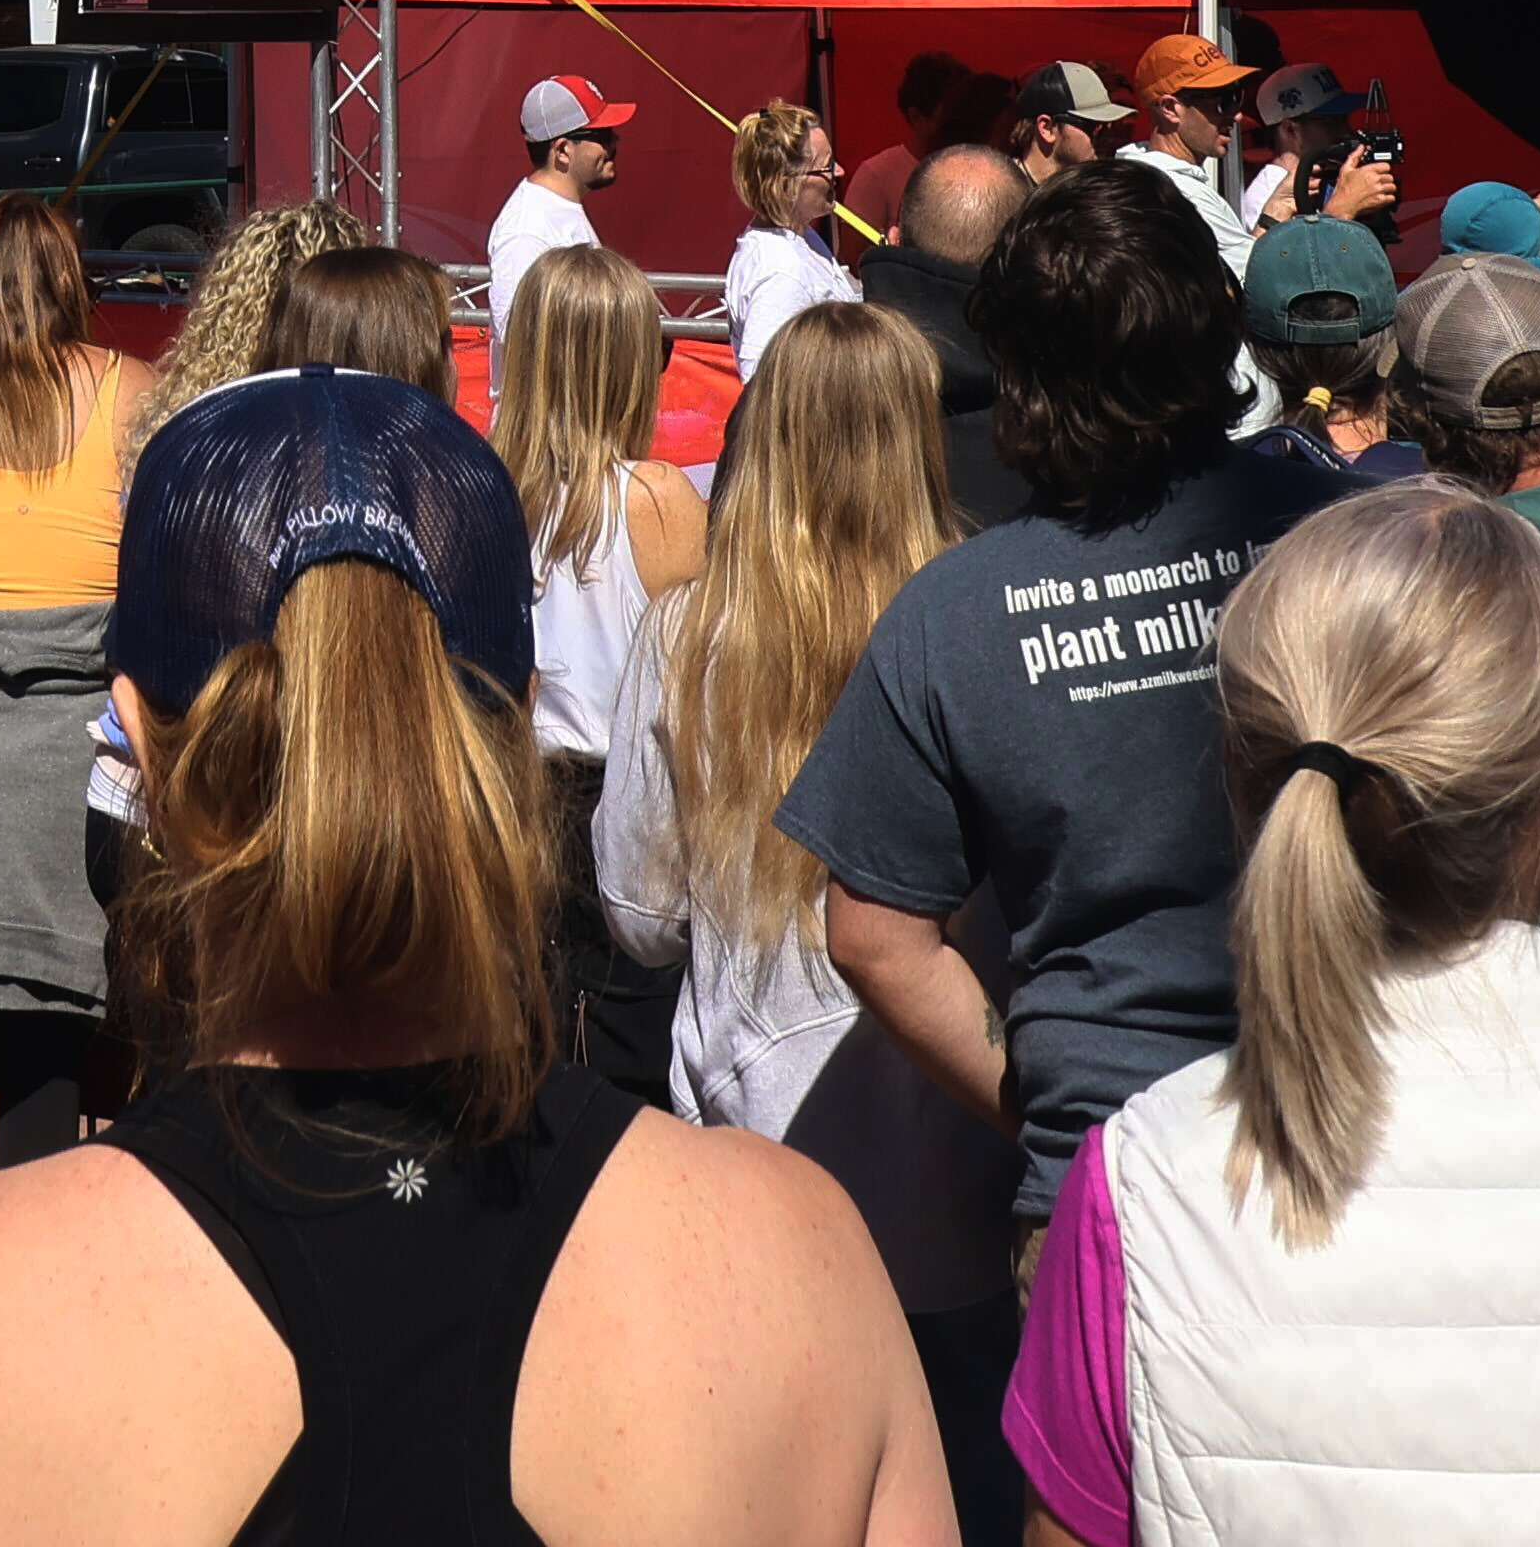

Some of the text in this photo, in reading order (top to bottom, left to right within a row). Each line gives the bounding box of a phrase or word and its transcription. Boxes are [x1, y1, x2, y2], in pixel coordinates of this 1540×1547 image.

[286, 503, 356, 538] PILLOW
[1005, 579, 1075, 614] Invite
[1082, 577, 1098, 602] a
[1103, 552, 1212, 598] monarch
[1215, 548, 1240, 578] to
[1020, 598, 1222, 684] plant milk
